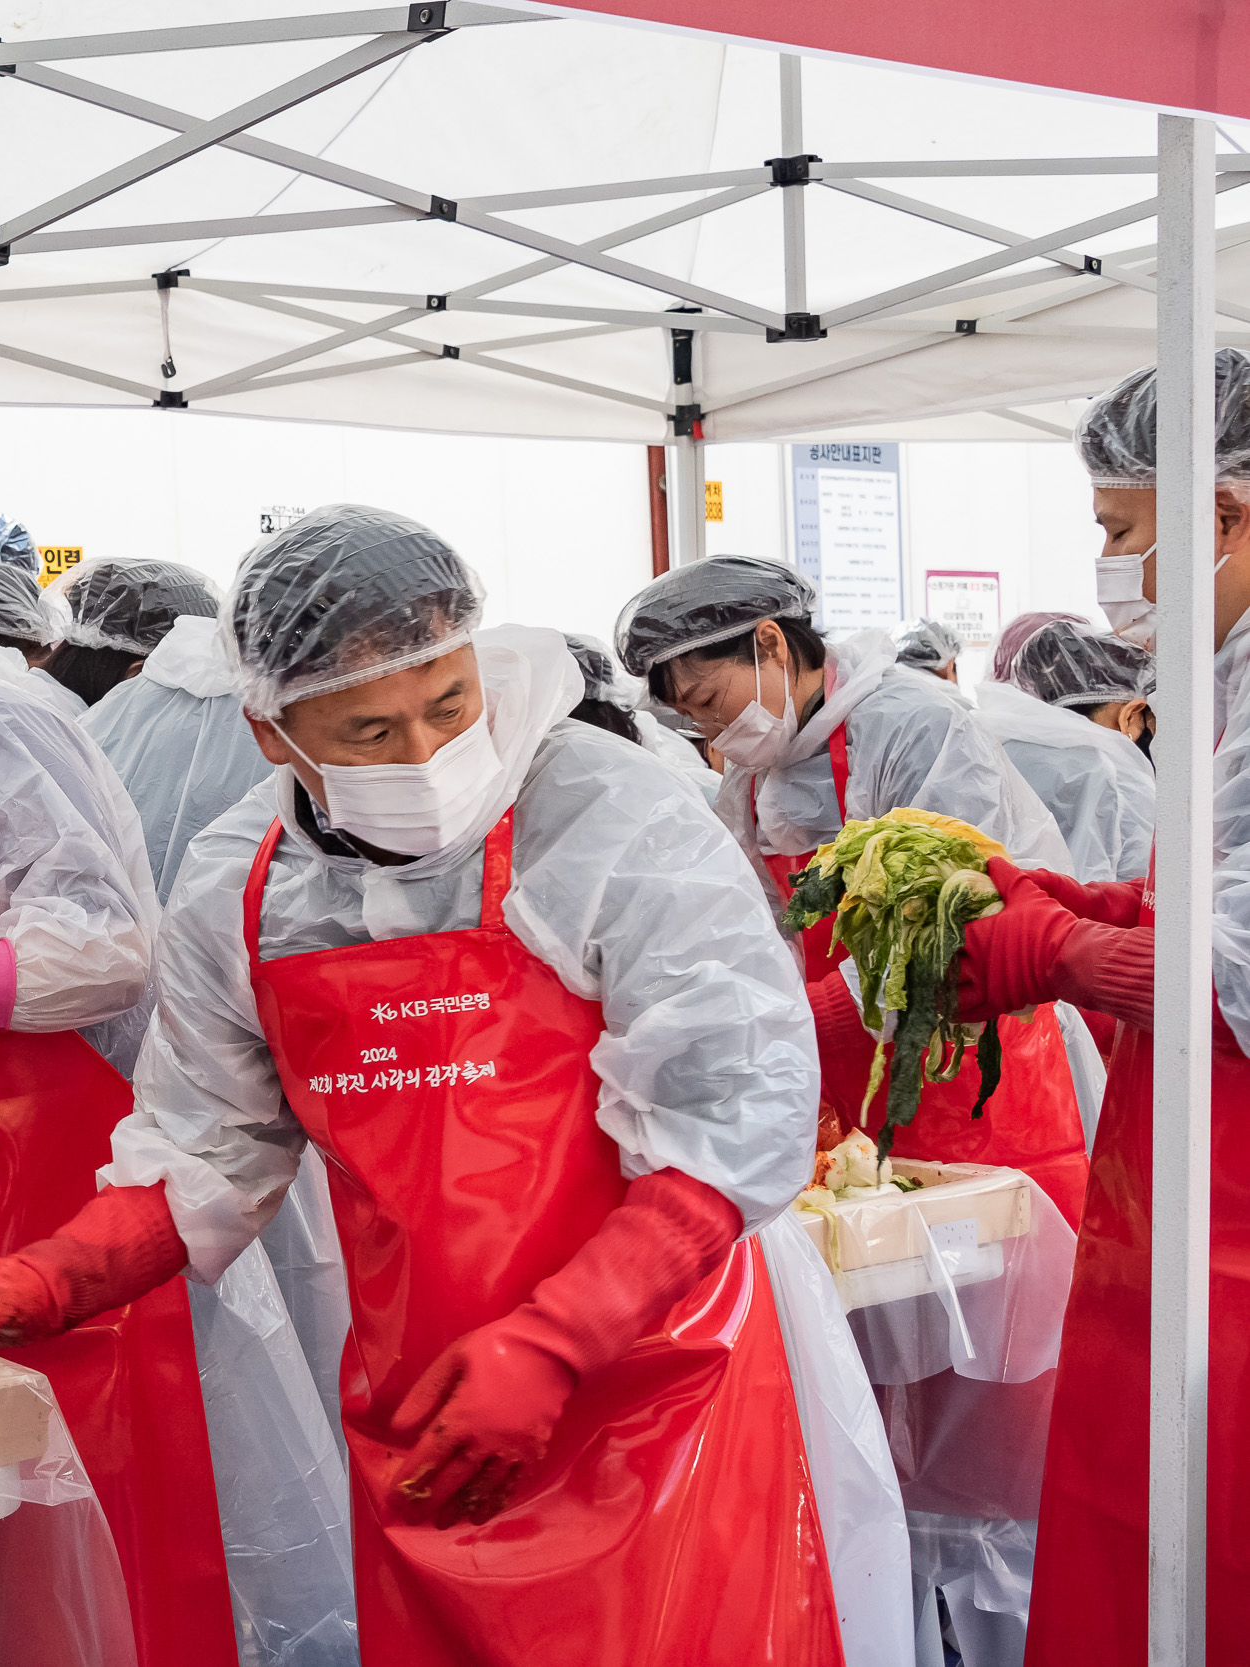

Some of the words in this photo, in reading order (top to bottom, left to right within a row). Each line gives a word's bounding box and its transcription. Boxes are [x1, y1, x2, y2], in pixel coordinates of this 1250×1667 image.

[809, 444, 882, 464] 공사안내표지판
[39, 549, 81, 574] 인력
[400, 992, 491, 1018] KB국민은행
[360, 1046, 398, 1064] 2024
[309, 1073, 333, 1094] 제2회
[335, 1072, 369, 1095] 광진
[370, 1067, 420, 1092] 사랑의
